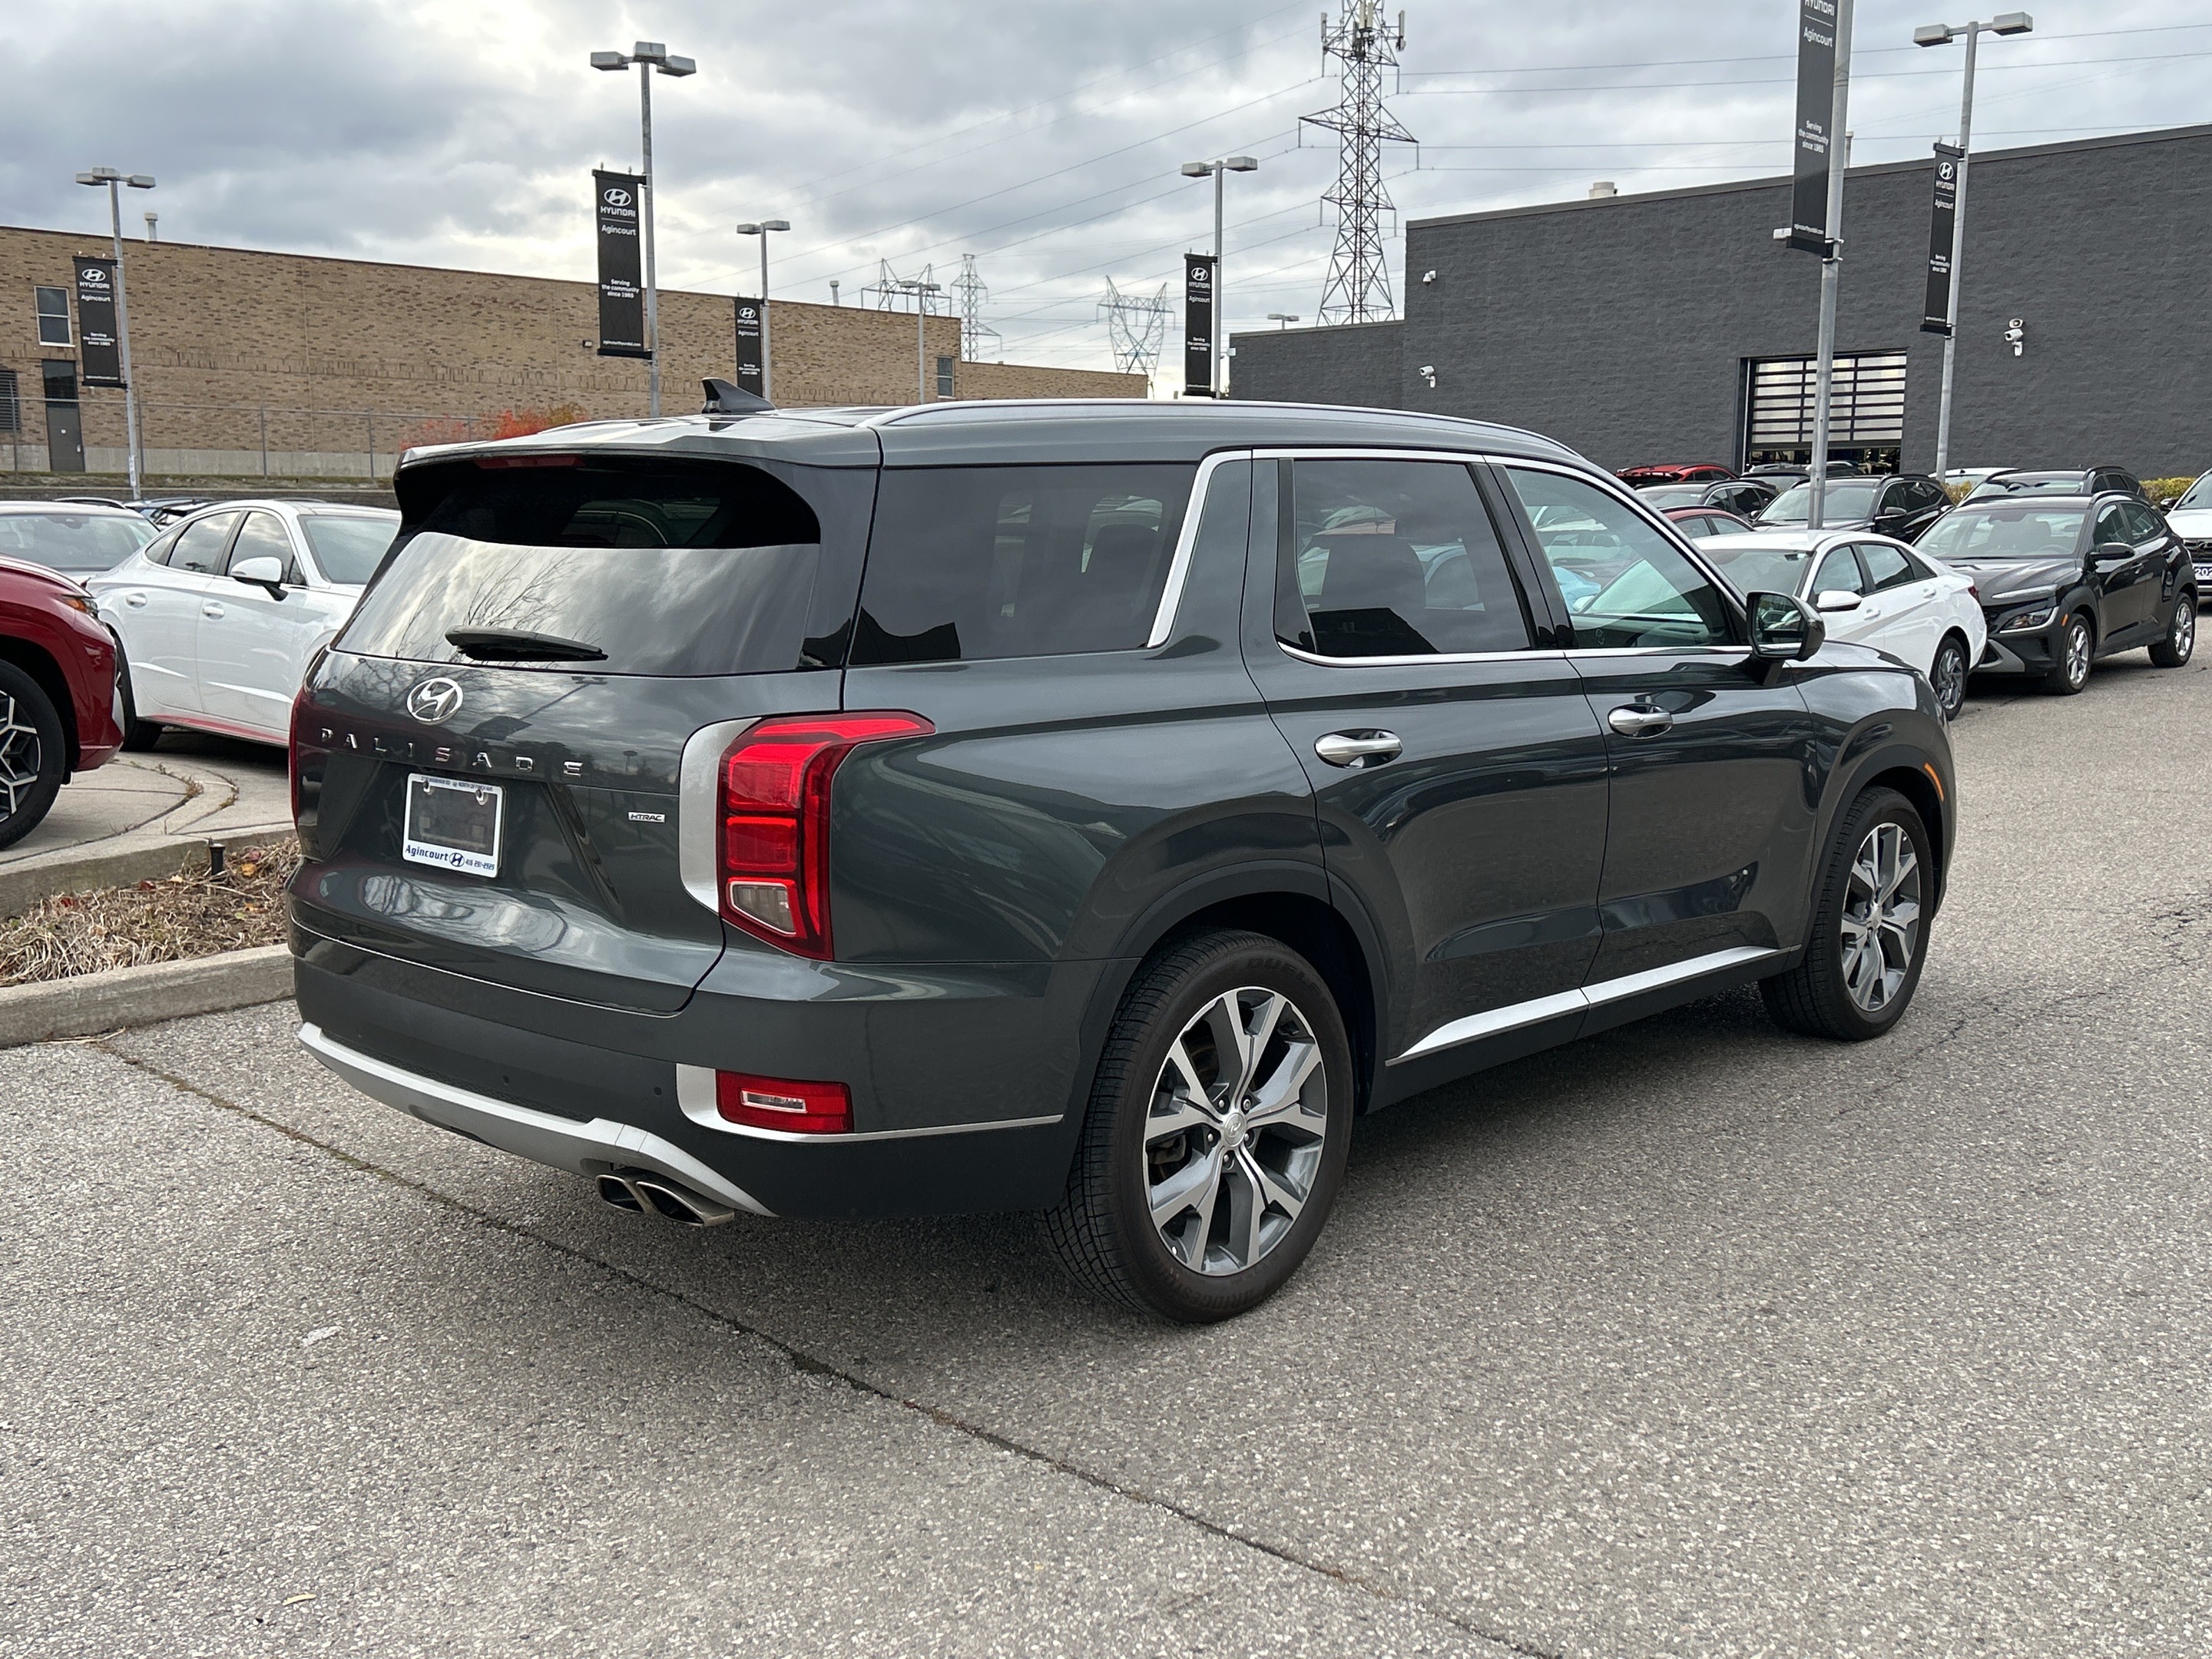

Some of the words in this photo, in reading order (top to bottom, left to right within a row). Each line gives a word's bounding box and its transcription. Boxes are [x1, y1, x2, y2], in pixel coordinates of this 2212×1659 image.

[1803, 27, 1833, 48] Agincourt
[1806, 120, 1823, 134] Serving
[1805, 131, 1829, 146] community
[1802, 139, 1813, 151] since
[600, 205, 636, 218] HYUNDAI
[601, 224, 637, 236] Agincourt
[79, 281, 110, 289] HYUNDAI
[611, 278, 631, 287] Serving
[1188, 281, 1210, 289] HYUNDAI
[611, 285, 640, 294] community
[81, 294, 111, 303] Agincourt
[320, 727, 584, 778] PALISADE
[405, 845, 449, 861] Agincourt
